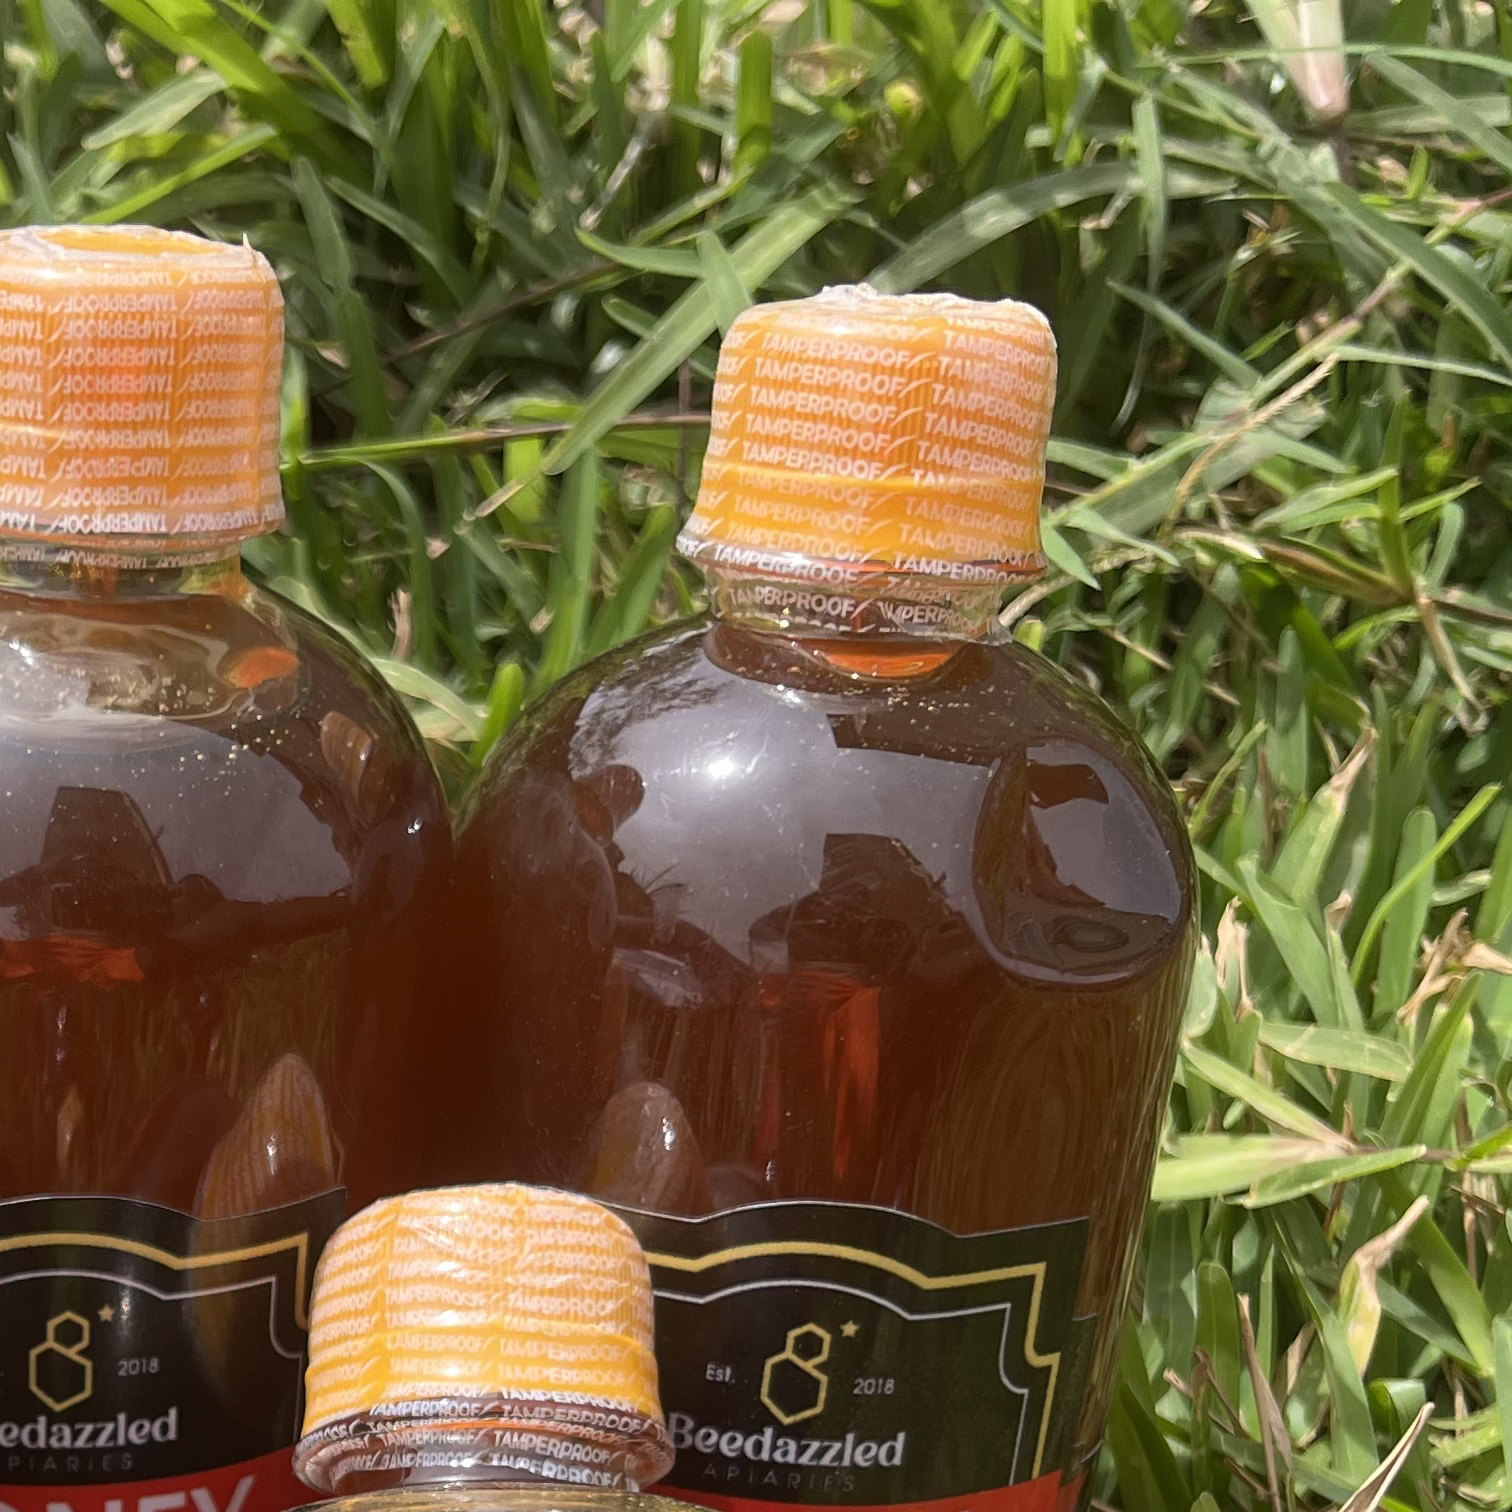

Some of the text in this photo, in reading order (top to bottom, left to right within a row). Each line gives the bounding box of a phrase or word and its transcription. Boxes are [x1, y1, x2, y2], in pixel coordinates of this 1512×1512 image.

[117, 1358, 161, 1376] 2018
[705, 1363, 895, 1396] Est. 2018
[668, 1412, 906, 1468] Beedazzled
[701, 1463, 856, 1492] APIARIES
